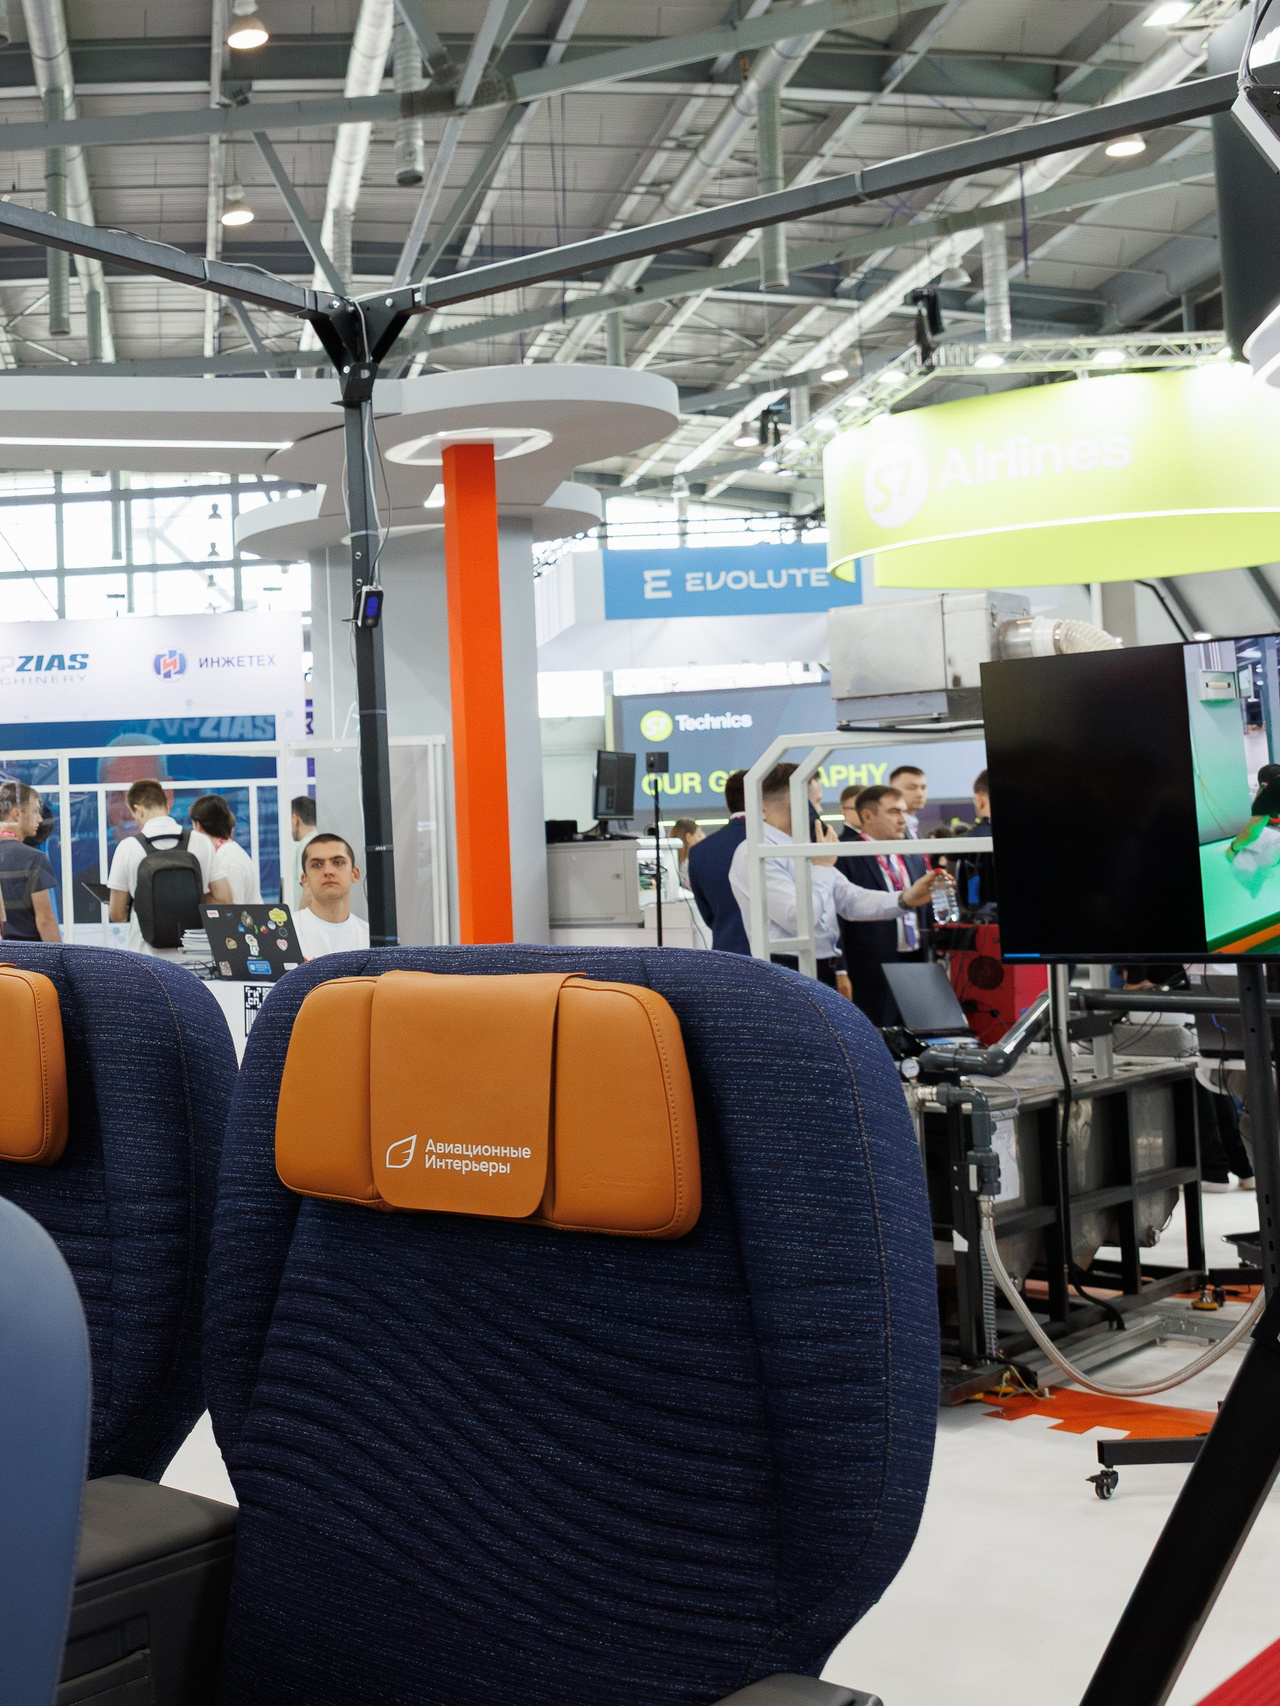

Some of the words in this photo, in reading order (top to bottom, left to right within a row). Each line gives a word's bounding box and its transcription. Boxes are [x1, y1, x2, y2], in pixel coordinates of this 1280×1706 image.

[936, 435, 1133, 492] Airlines
[685, 568, 830, 592] EVOLUTE
[198, 654, 277, 668] ИНЖЕТЕХ
[675, 712, 753, 732] Technics
[641, 771, 702, 796] OUR
[708, 763, 888, 793] GAPHY
[425, 1138, 531, 1159] Авиационные
[425, 1154, 511, 1177] Интерьеры
